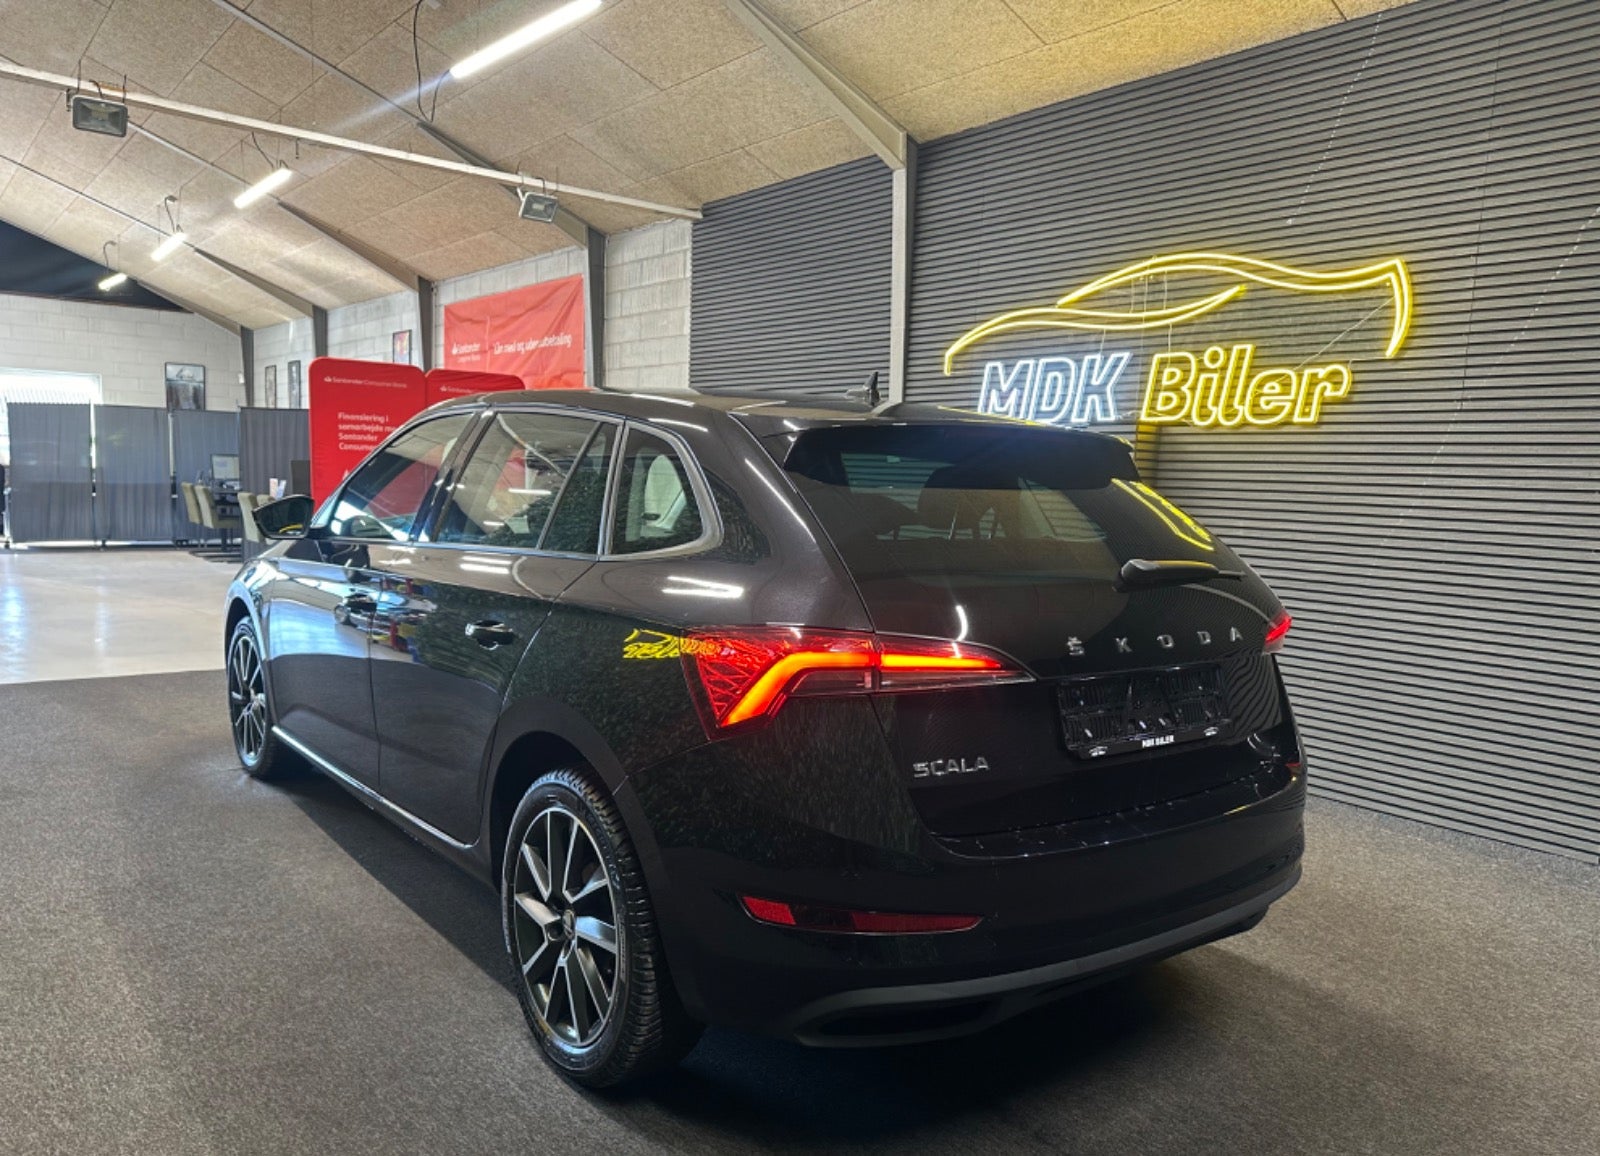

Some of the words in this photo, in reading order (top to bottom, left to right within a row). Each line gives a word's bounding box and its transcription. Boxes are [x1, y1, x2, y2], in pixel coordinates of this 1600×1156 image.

[977, 351, 1132, 425] MDK
[1141, 344, 1353, 427] Biler
[338, 412, 385, 424] Finansiering
[338, 424, 384, 433] samarbejde
[338, 432, 378, 442] Santander
[338, 442, 378, 451] Consume
[1067, 626, 1243, 656] ŠKODA
[912, 756, 990, 778] SCALA
